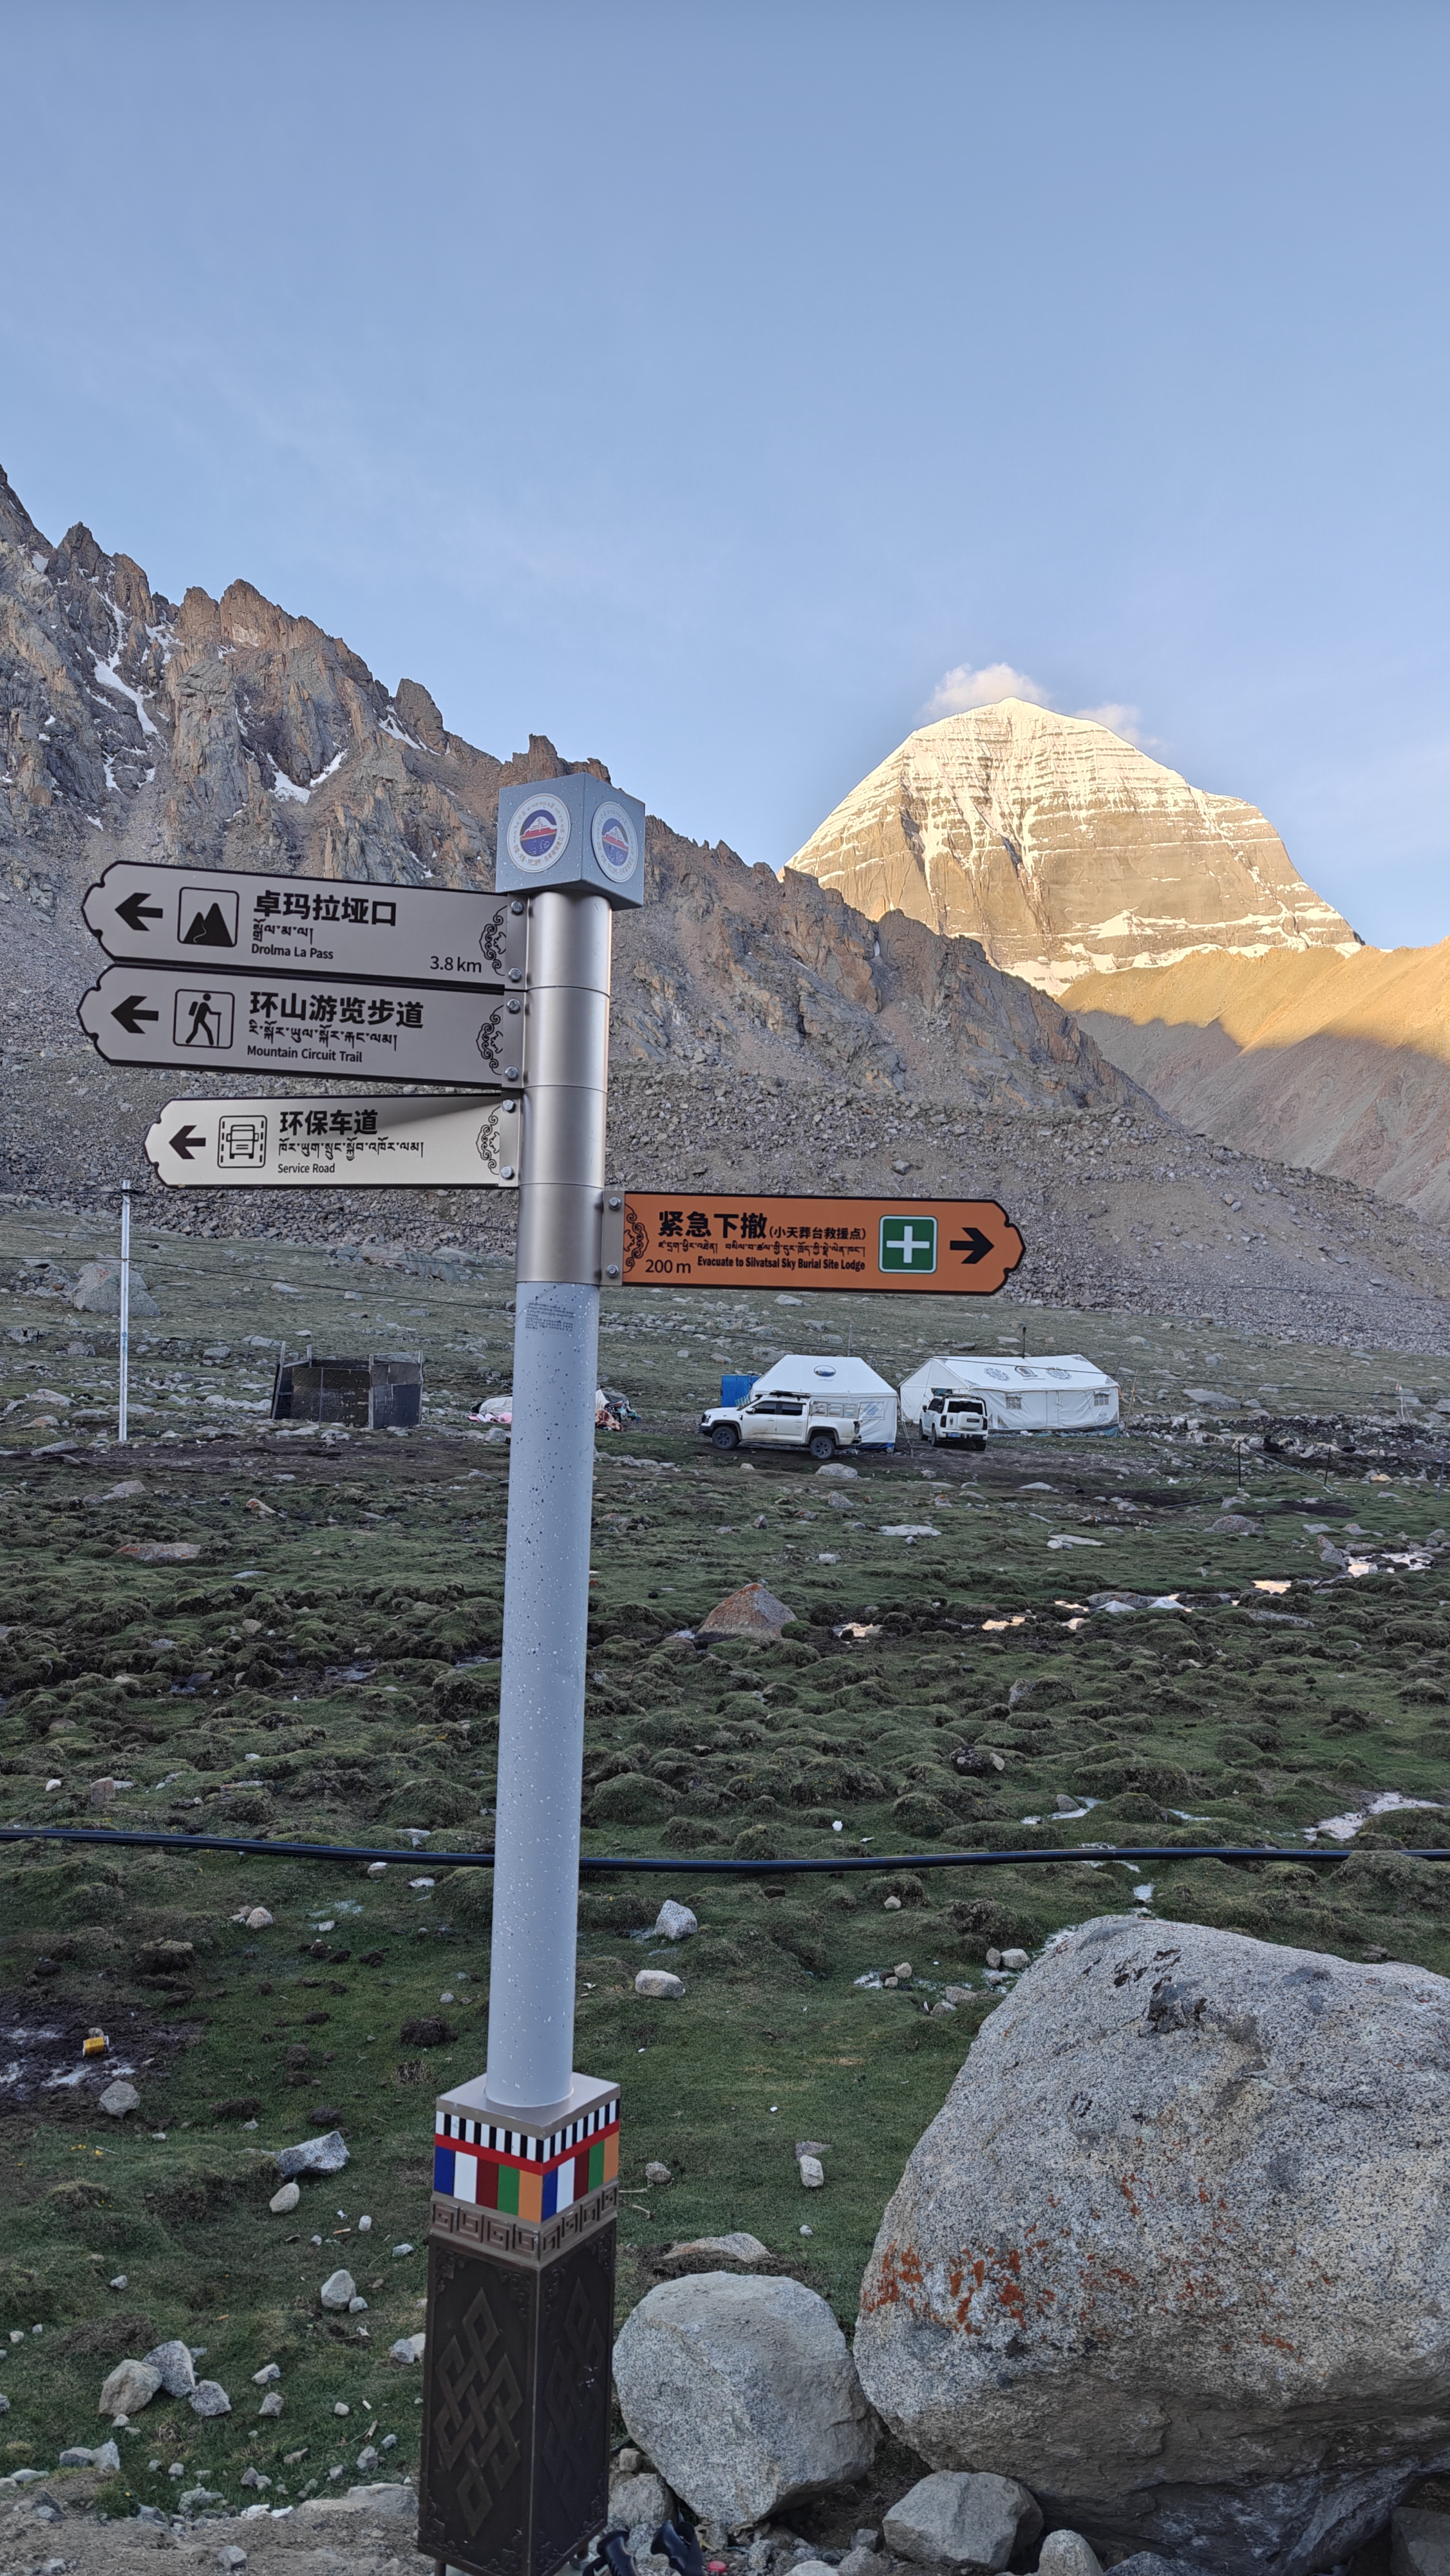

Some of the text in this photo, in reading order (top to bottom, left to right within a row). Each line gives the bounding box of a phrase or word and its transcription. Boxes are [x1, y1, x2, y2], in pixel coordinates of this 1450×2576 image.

[254, 889, 397, 927] 卓玛拉垭口
[251, 943, 334, 960] Drolma La Pass
[430, 956, 482, 973] 3.8 km
[249, 991, 424, 1028] 环山游览步道
[247, 1045, 362, 1063] Mountain Circuit Trail
[279, 1108, 379, 1136] 环保车道
[278, 1162, 335, 1173] Service Road
[658, 1211, 767, 1239] 紧急下撤
[645, 1259, 691, 1274] 200 m
[697, 1256, 865, 1273] Evacuate to Silvatsal Sky Burial Site Lodge
